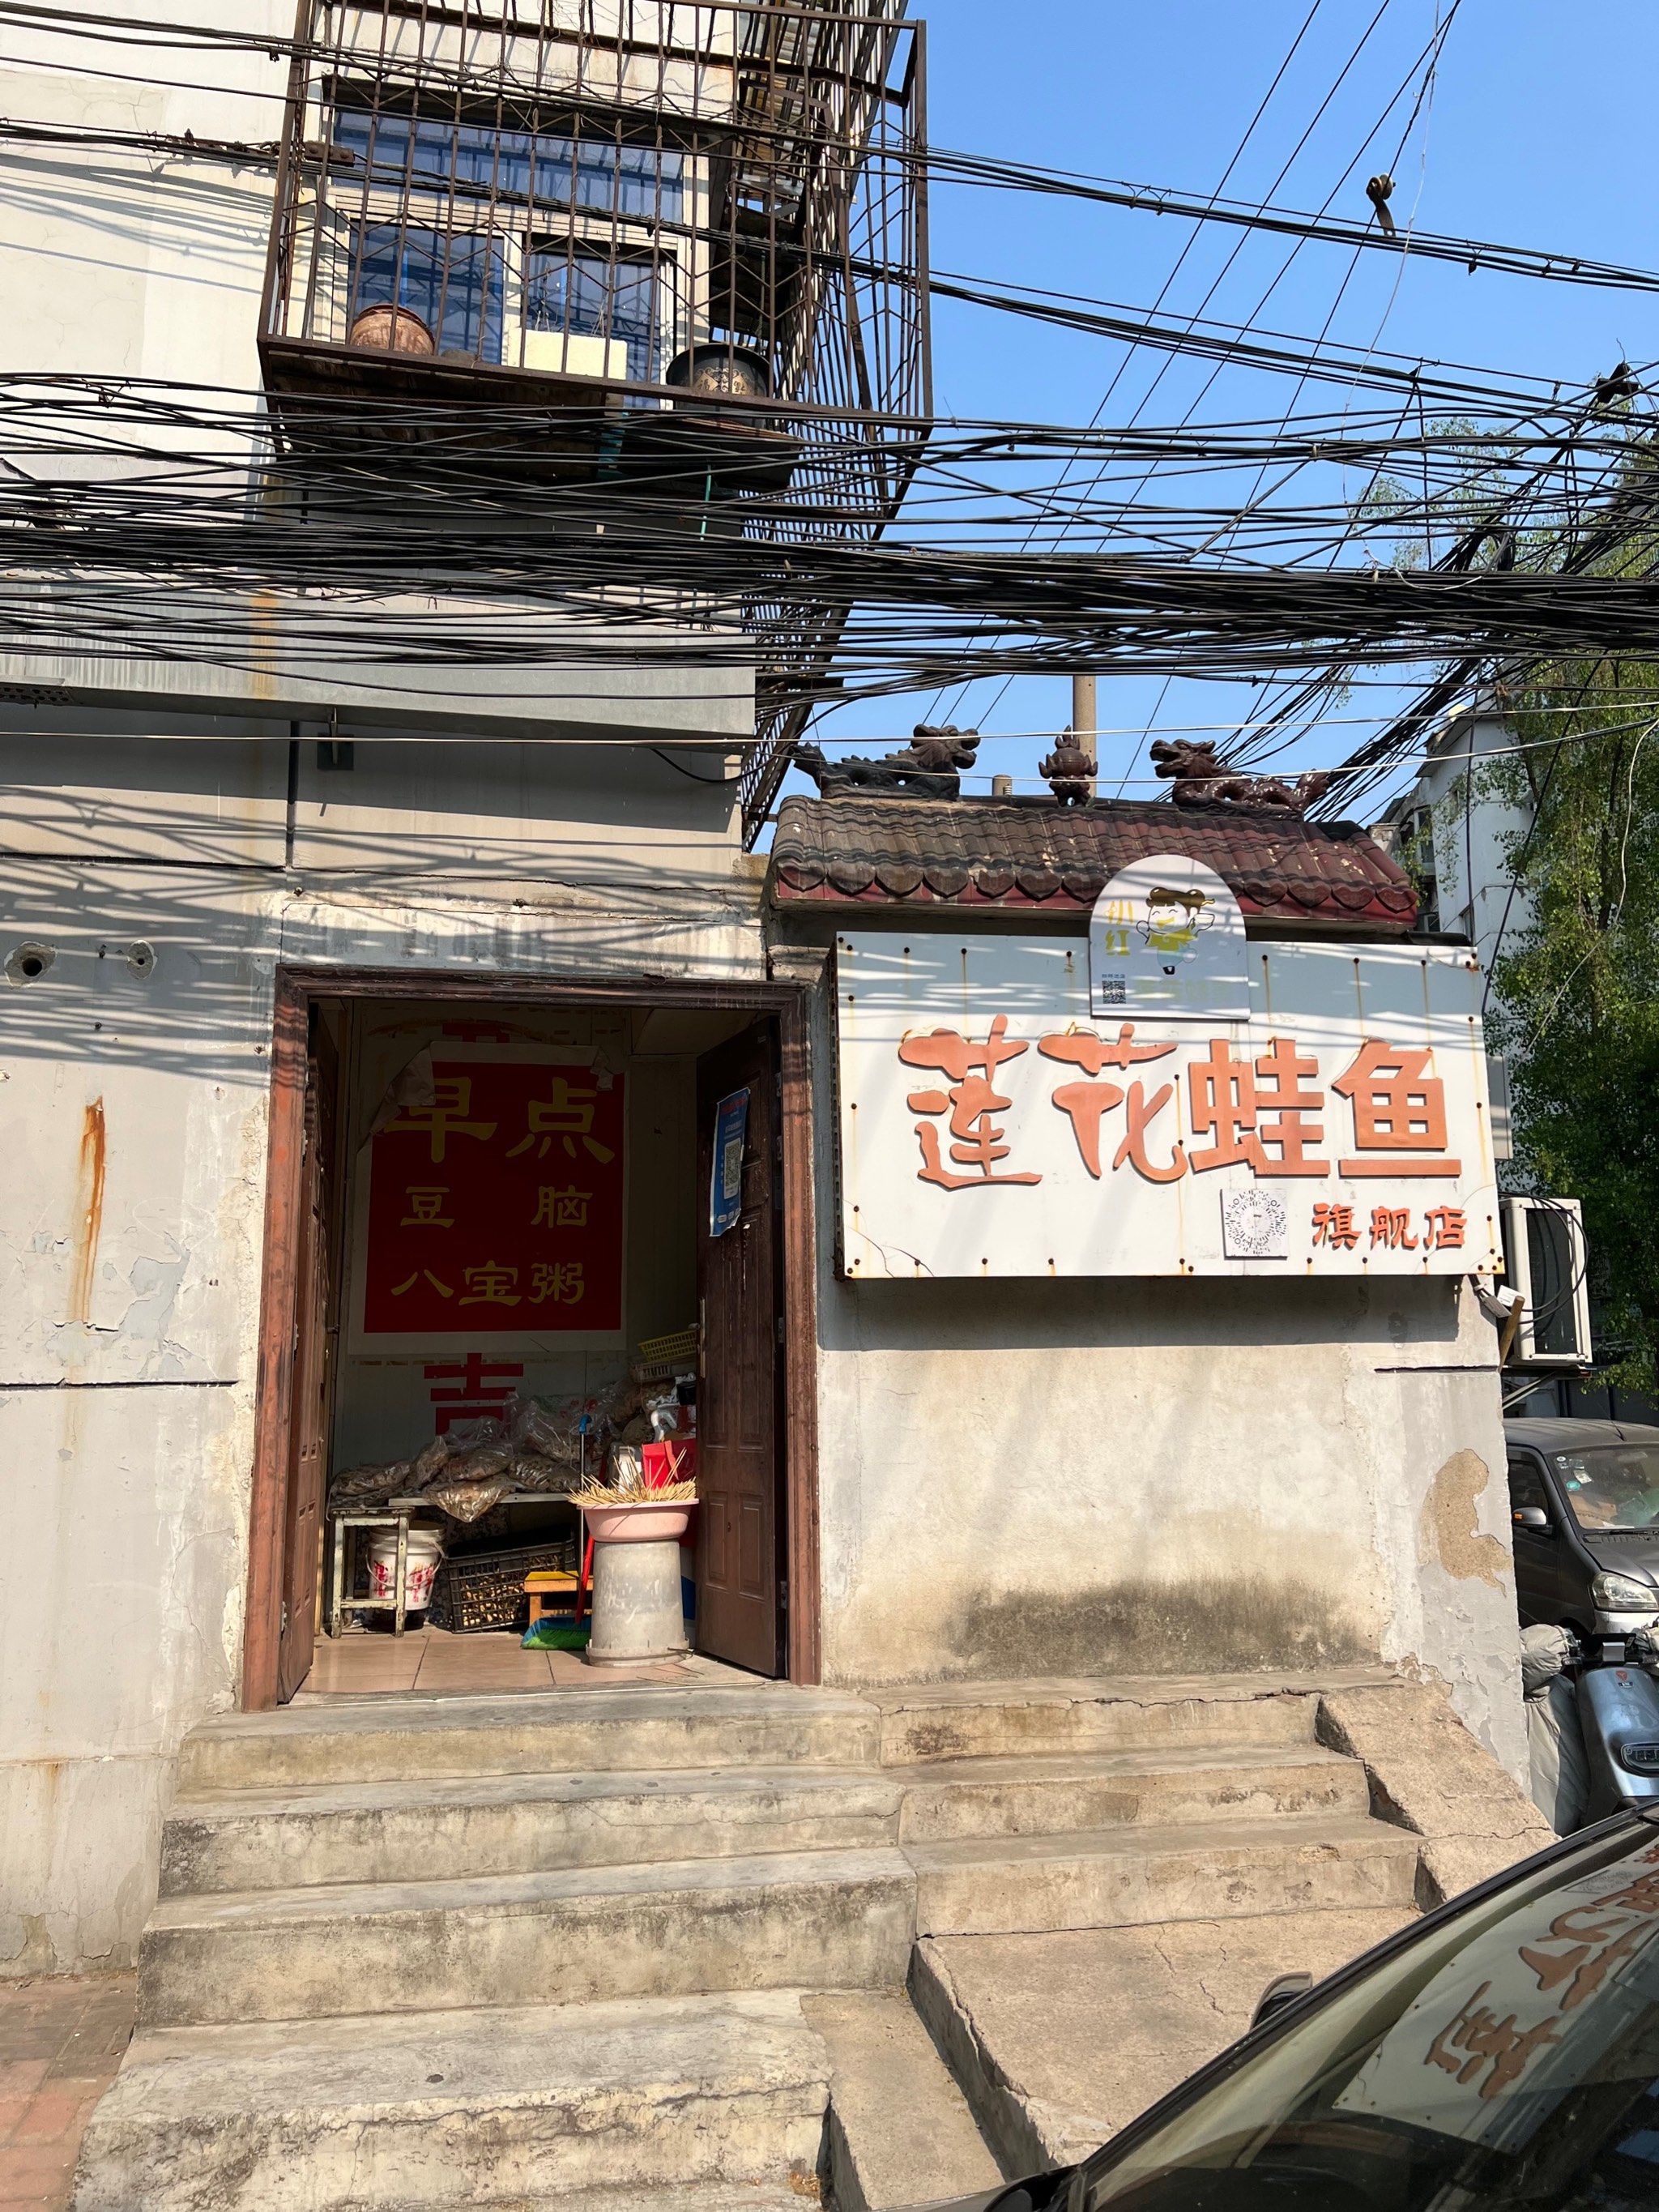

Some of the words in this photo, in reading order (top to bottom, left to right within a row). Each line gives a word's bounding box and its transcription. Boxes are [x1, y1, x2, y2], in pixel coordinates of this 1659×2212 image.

[384, 1076, 616, 1164] 早点
[898, 1013, 1461, 1190] 莲花蛙鱼
[399, 1186, 455, 1227] 豆
[531, 1185, 593, 1228] 脑
[1311, 1202, 1468, 1251] 旗舰店
[390, 1260, 585, 1307] 八宝粥
